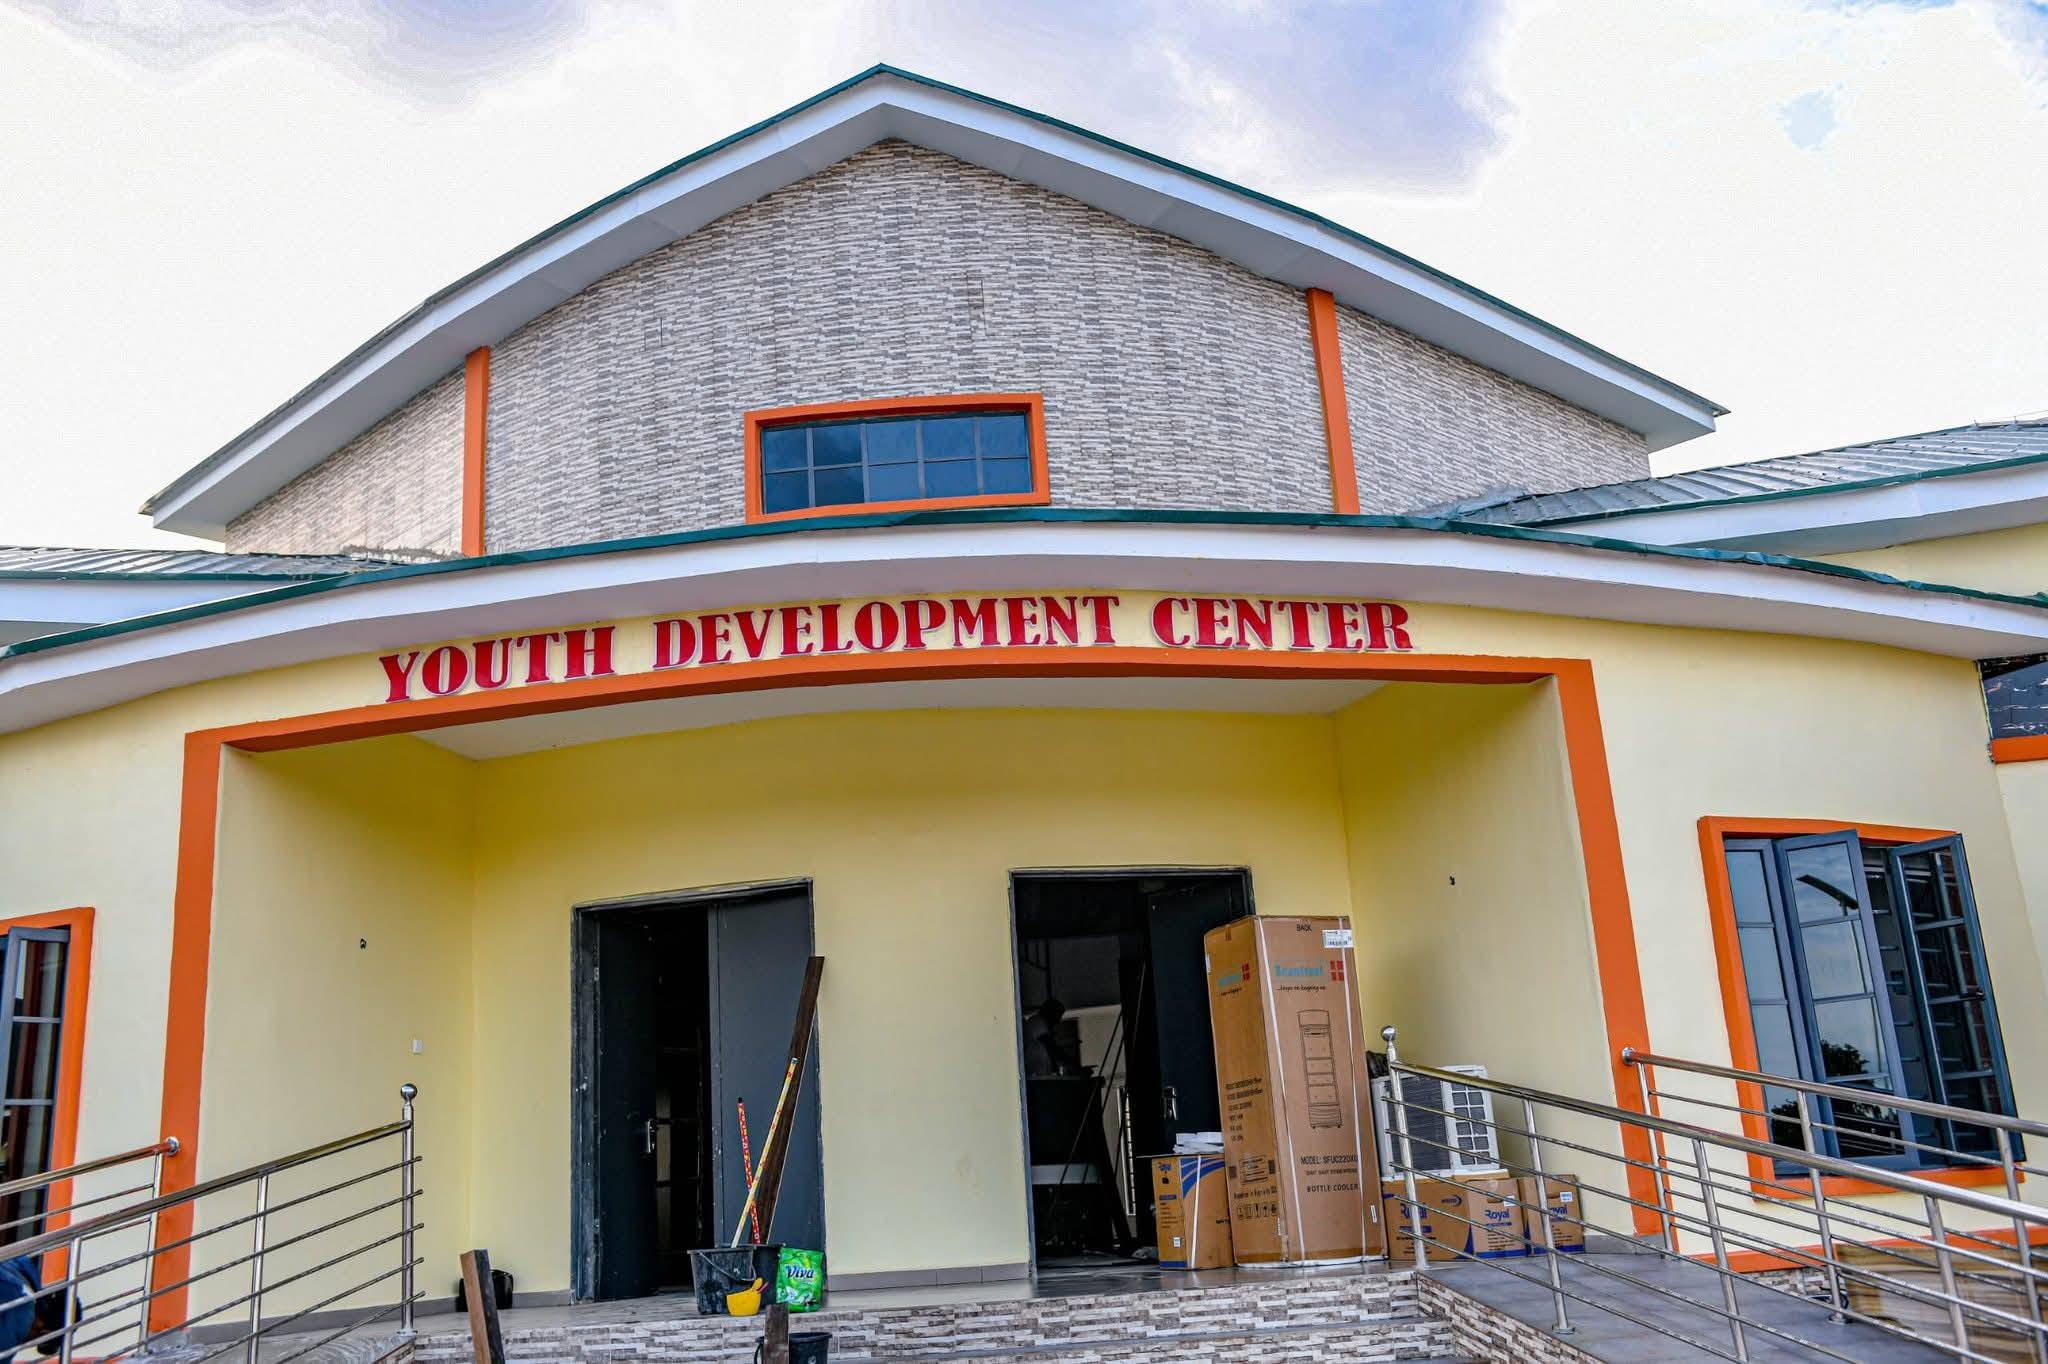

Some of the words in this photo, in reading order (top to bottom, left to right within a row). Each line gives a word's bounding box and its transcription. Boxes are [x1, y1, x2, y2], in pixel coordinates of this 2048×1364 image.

[382, 626, 615, 703] YOUTH
[653, 596, 1118, 669] DEVELOPMENT
[1152, 597, 1414, 650] CENTER
[1296, 924, 1312, 932] BACK
[1307, 1184, 1331, 1192] BOTTLE
[1332, 1183, 1359, 1192] COOLER
[1484, 1207, 1510, 1221] Royal
[785, 1265, 815, 1279] Viva
